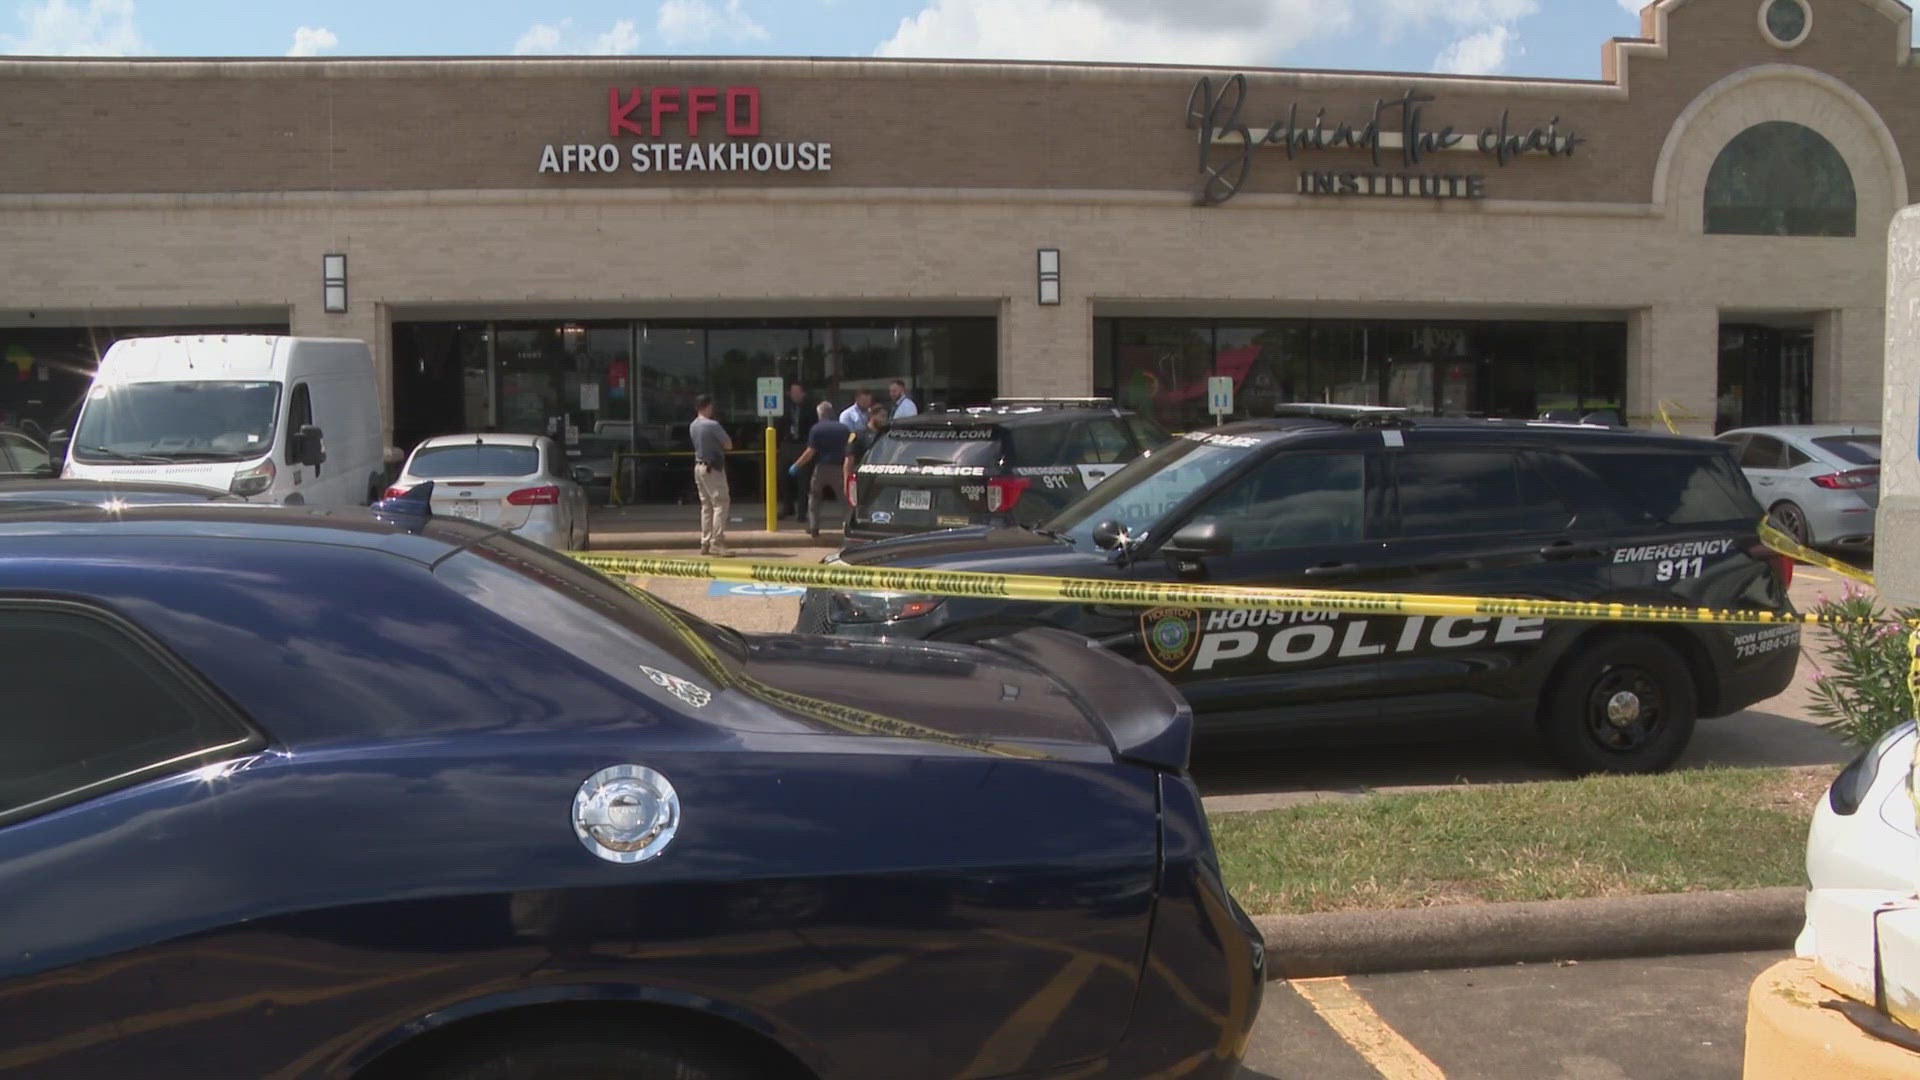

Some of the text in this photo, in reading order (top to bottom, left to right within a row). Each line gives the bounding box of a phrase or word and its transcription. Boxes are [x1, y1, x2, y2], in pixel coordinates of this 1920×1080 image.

[608, 86, 761, 137] KFFO
[1186, 73, 1386, 205] Behind
[1476, 107, 1587, 168] chair
[538, 142, 832, 173] AFRO STEAKHOUSE
[1299, 170, 1487, 199] INSTITUTE
[857, 463, 986, 477] HOUSTON POLICE
[1042, 475, 1070, 490] 911
[1613, 538, 1734, 565] EMERGENCY
[1656, 556, 1704, 582] 911
[1206, 608, 1341, 632] HOUSTON
[1192, 615, 1546, 672] POLICE
[1733, 632, 1757, 647] NON
